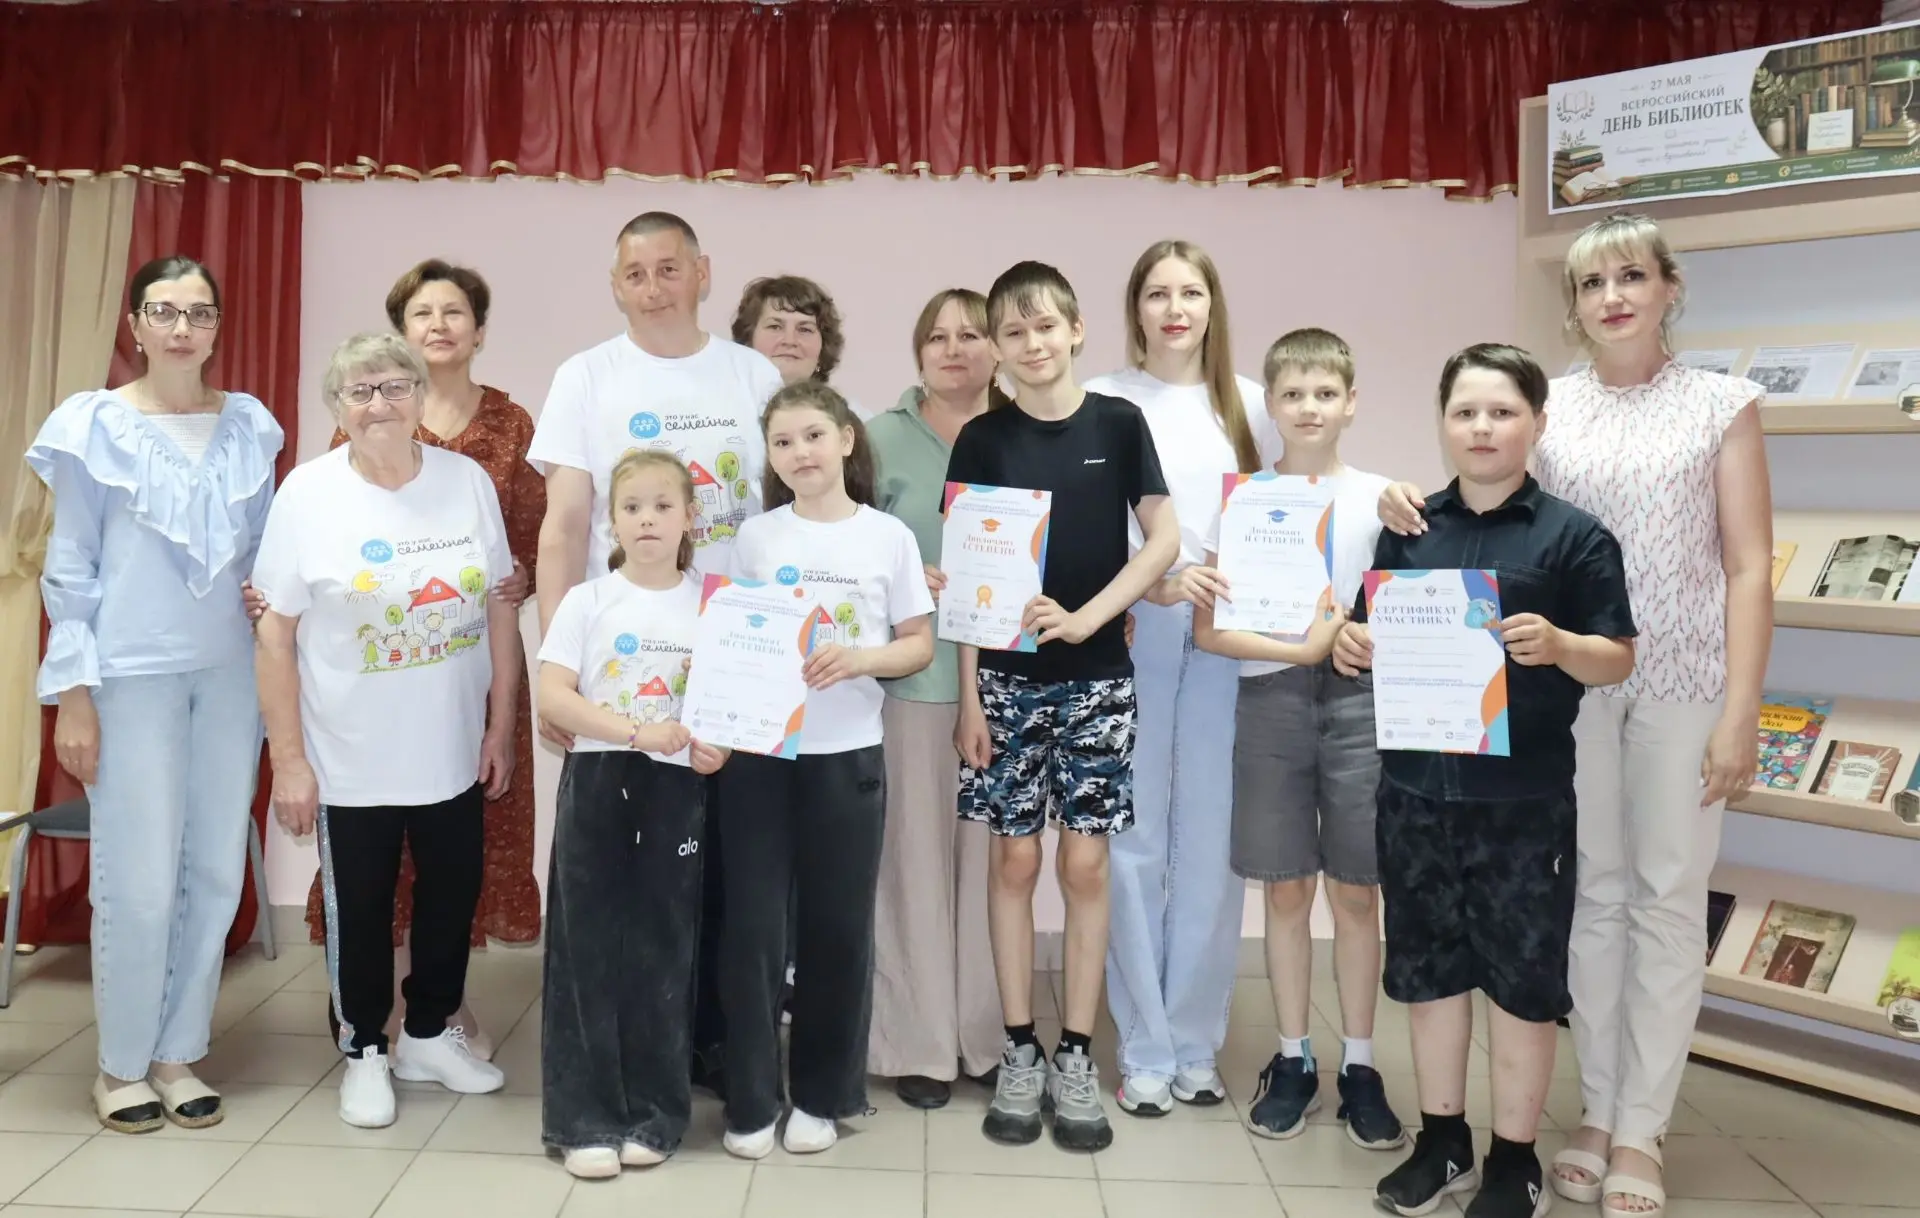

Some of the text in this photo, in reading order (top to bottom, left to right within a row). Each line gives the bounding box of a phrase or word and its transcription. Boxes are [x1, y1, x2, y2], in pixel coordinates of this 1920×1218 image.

[1650, 74, 1692, 90] 27 МАЯ
[1621, 85, 1725, 111] ВСЕРОССИЙСКИЙ
[1601, 98, 1744, 135] ДЕНЬ БИБЛИОТЕК
[664, 416, 738, 431] семейное
[397, 536, 472, 555] семейное
[802, 574, 860, 586] семейное
[1375, 605, 1456, 615] СЕРТИФИКАТ
[1376, 616, 1452, 625] УЧАСТНИКА
[678, 836, 698, 856] alo
